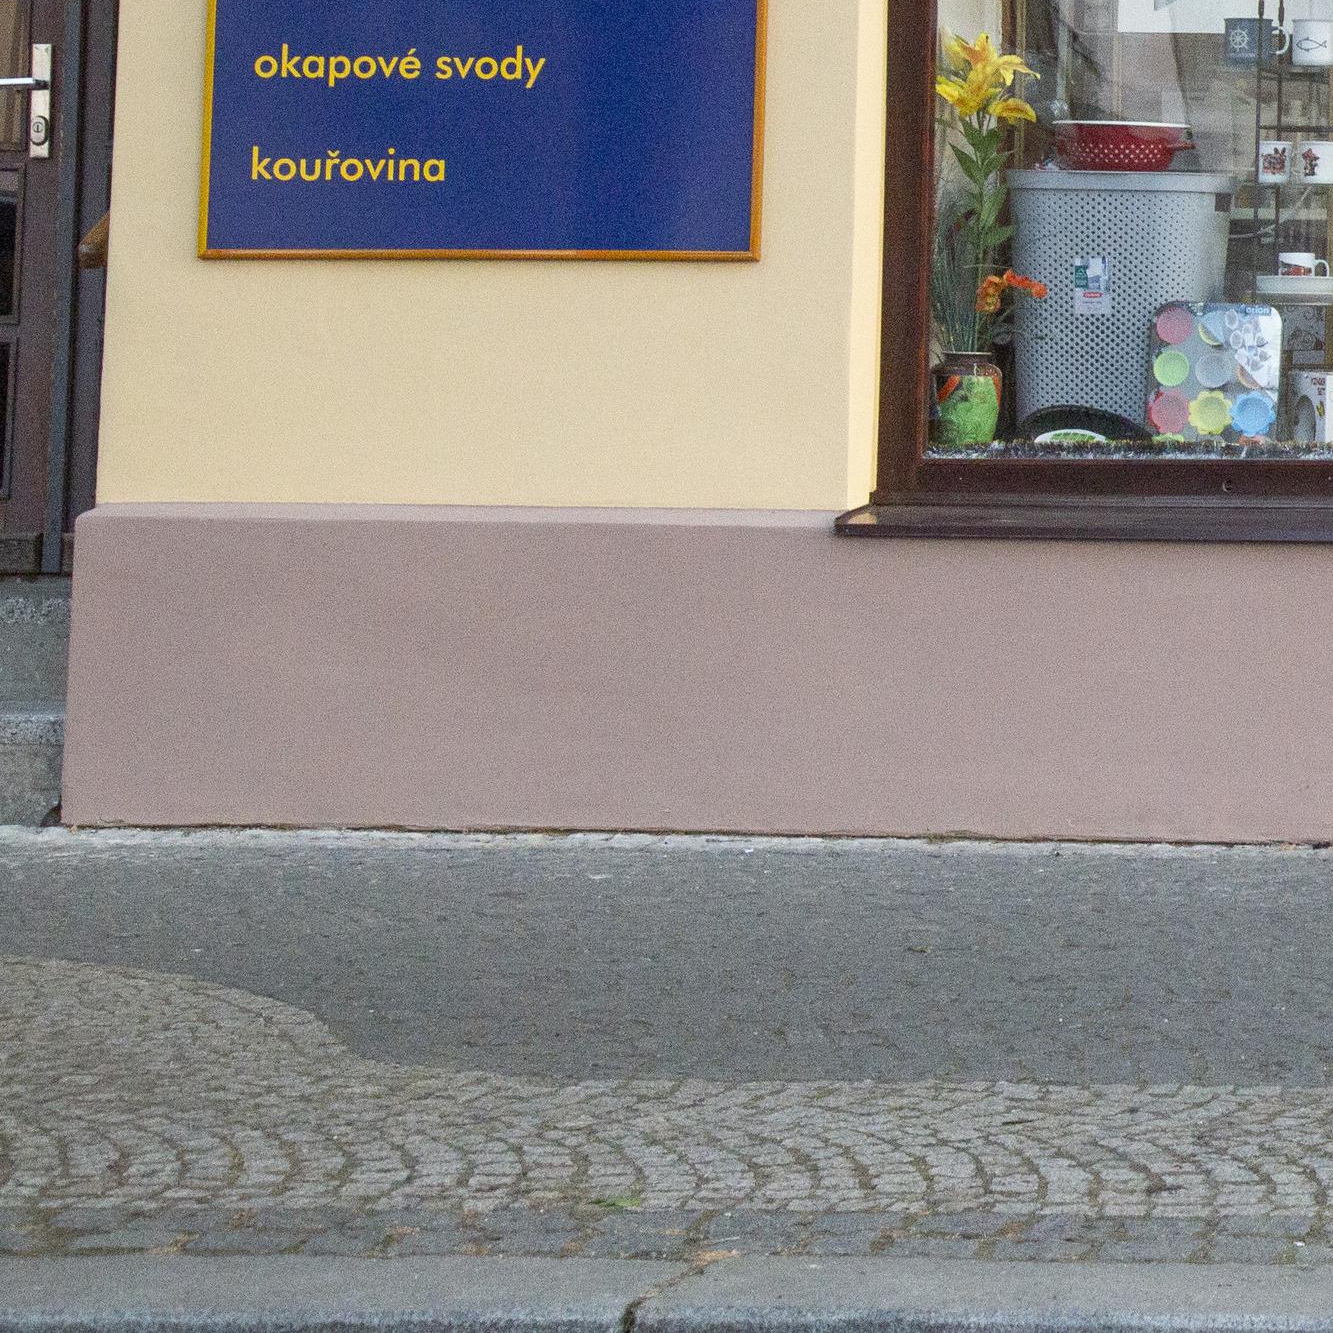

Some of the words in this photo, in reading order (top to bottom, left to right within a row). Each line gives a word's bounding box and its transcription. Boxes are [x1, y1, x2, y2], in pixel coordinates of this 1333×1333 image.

[254, 44, 423, 89] okapové
[436, 45, 547, 90] svody
[251, 146, 447, 183] kouřovina
